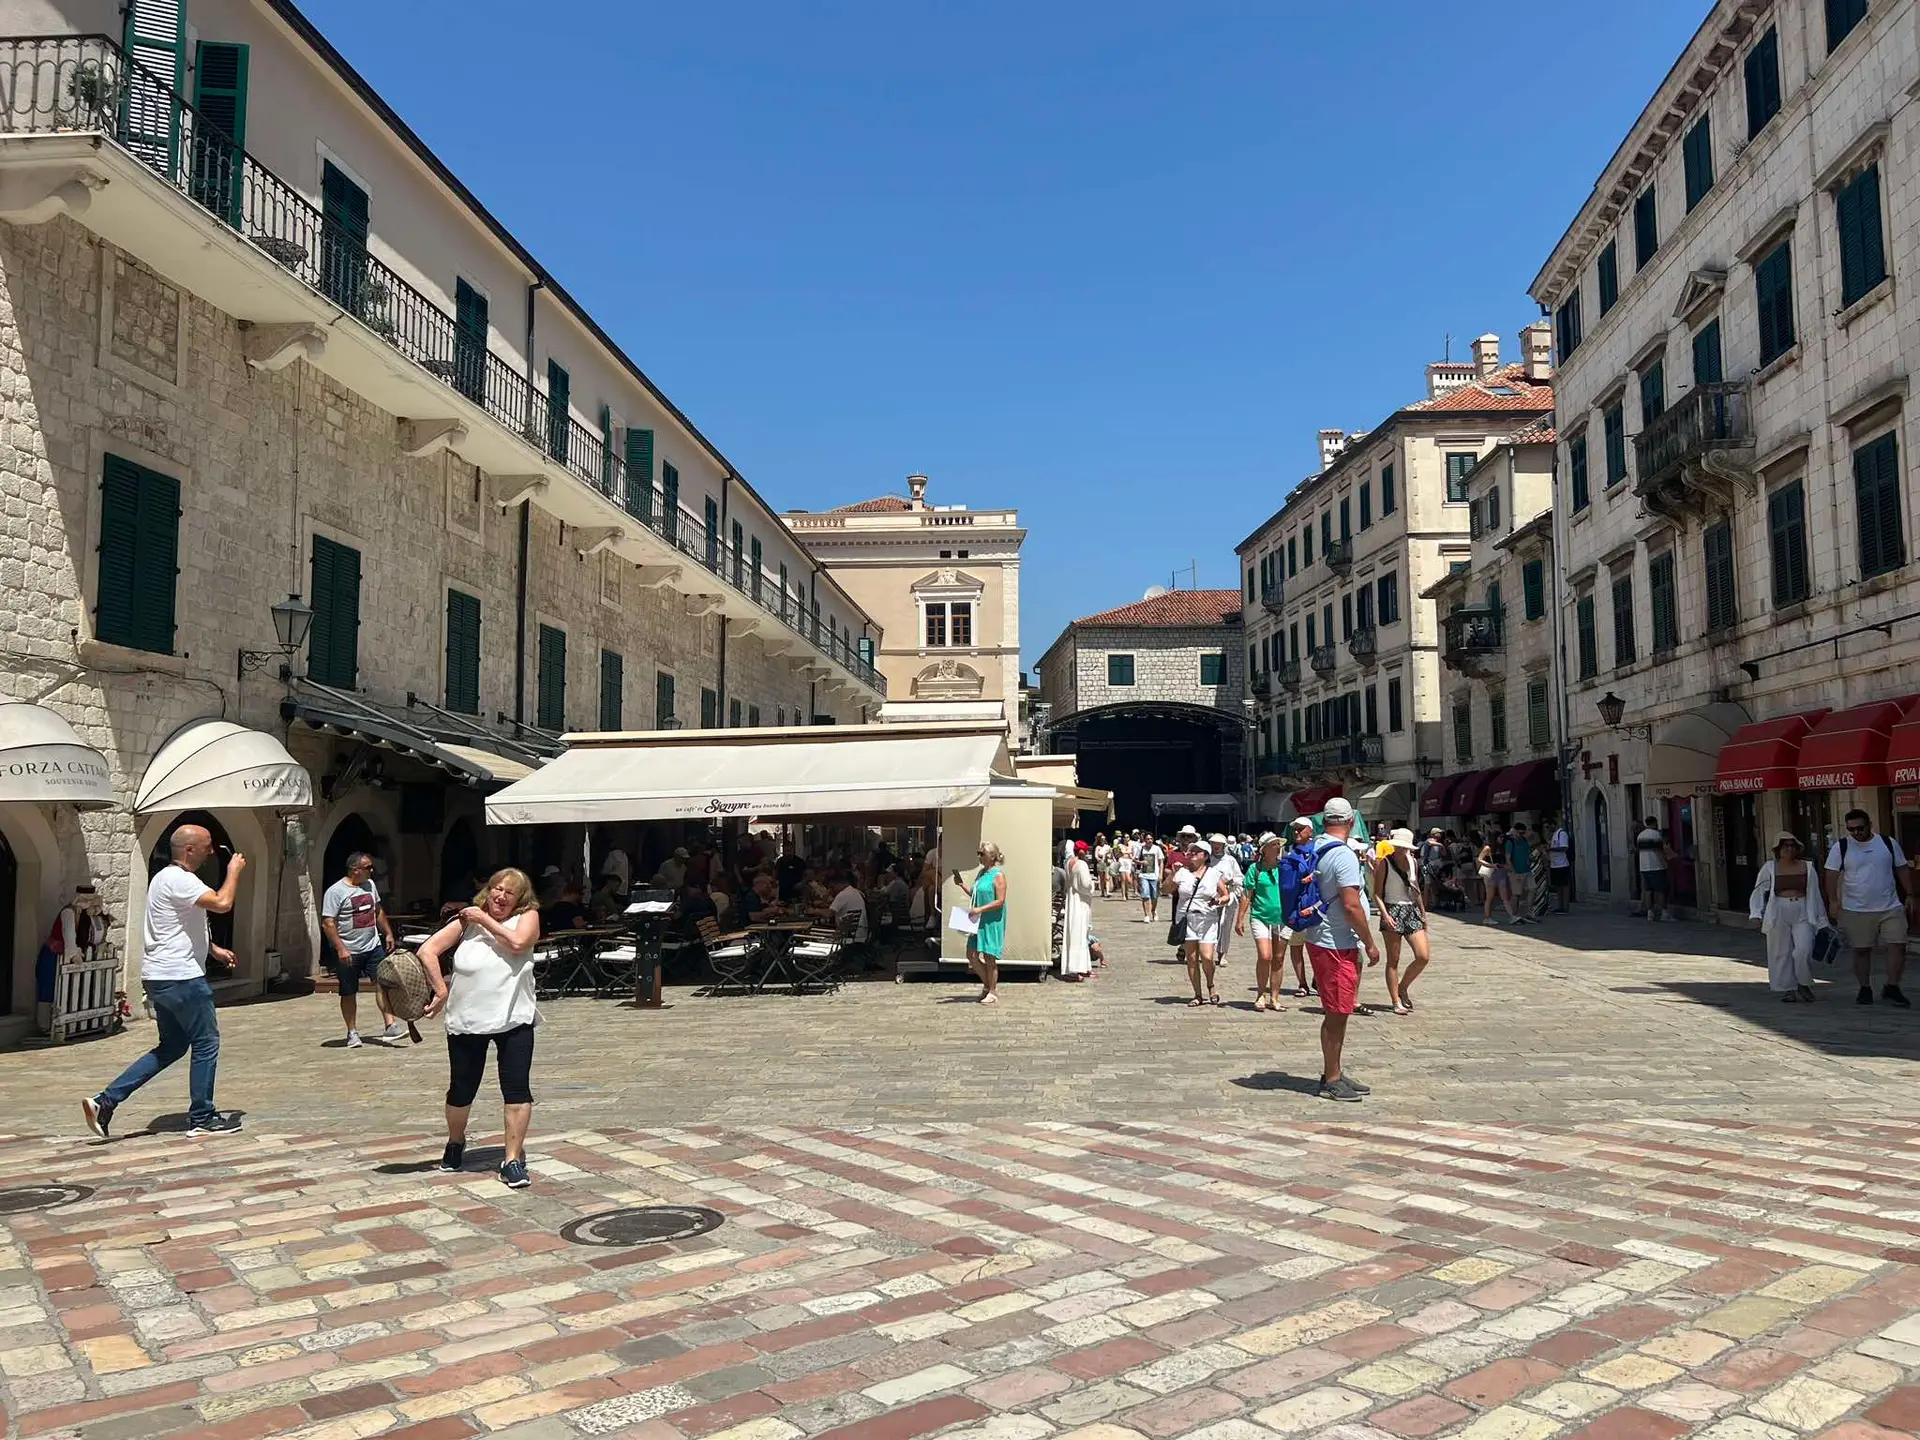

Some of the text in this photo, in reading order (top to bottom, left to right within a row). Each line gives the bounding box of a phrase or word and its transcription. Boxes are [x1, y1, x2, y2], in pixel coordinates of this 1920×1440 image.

[0, 762, 62, 777] FORZA
[1895, 767, 1917, 782] PRVA
[243, 778, 285, 789] FORZA
[1733, 778, 1753, 789] BANKA
[1799, 772, 1855, 787] PRVA BANKA CG
[704, 799, 751, 814] Siempre
